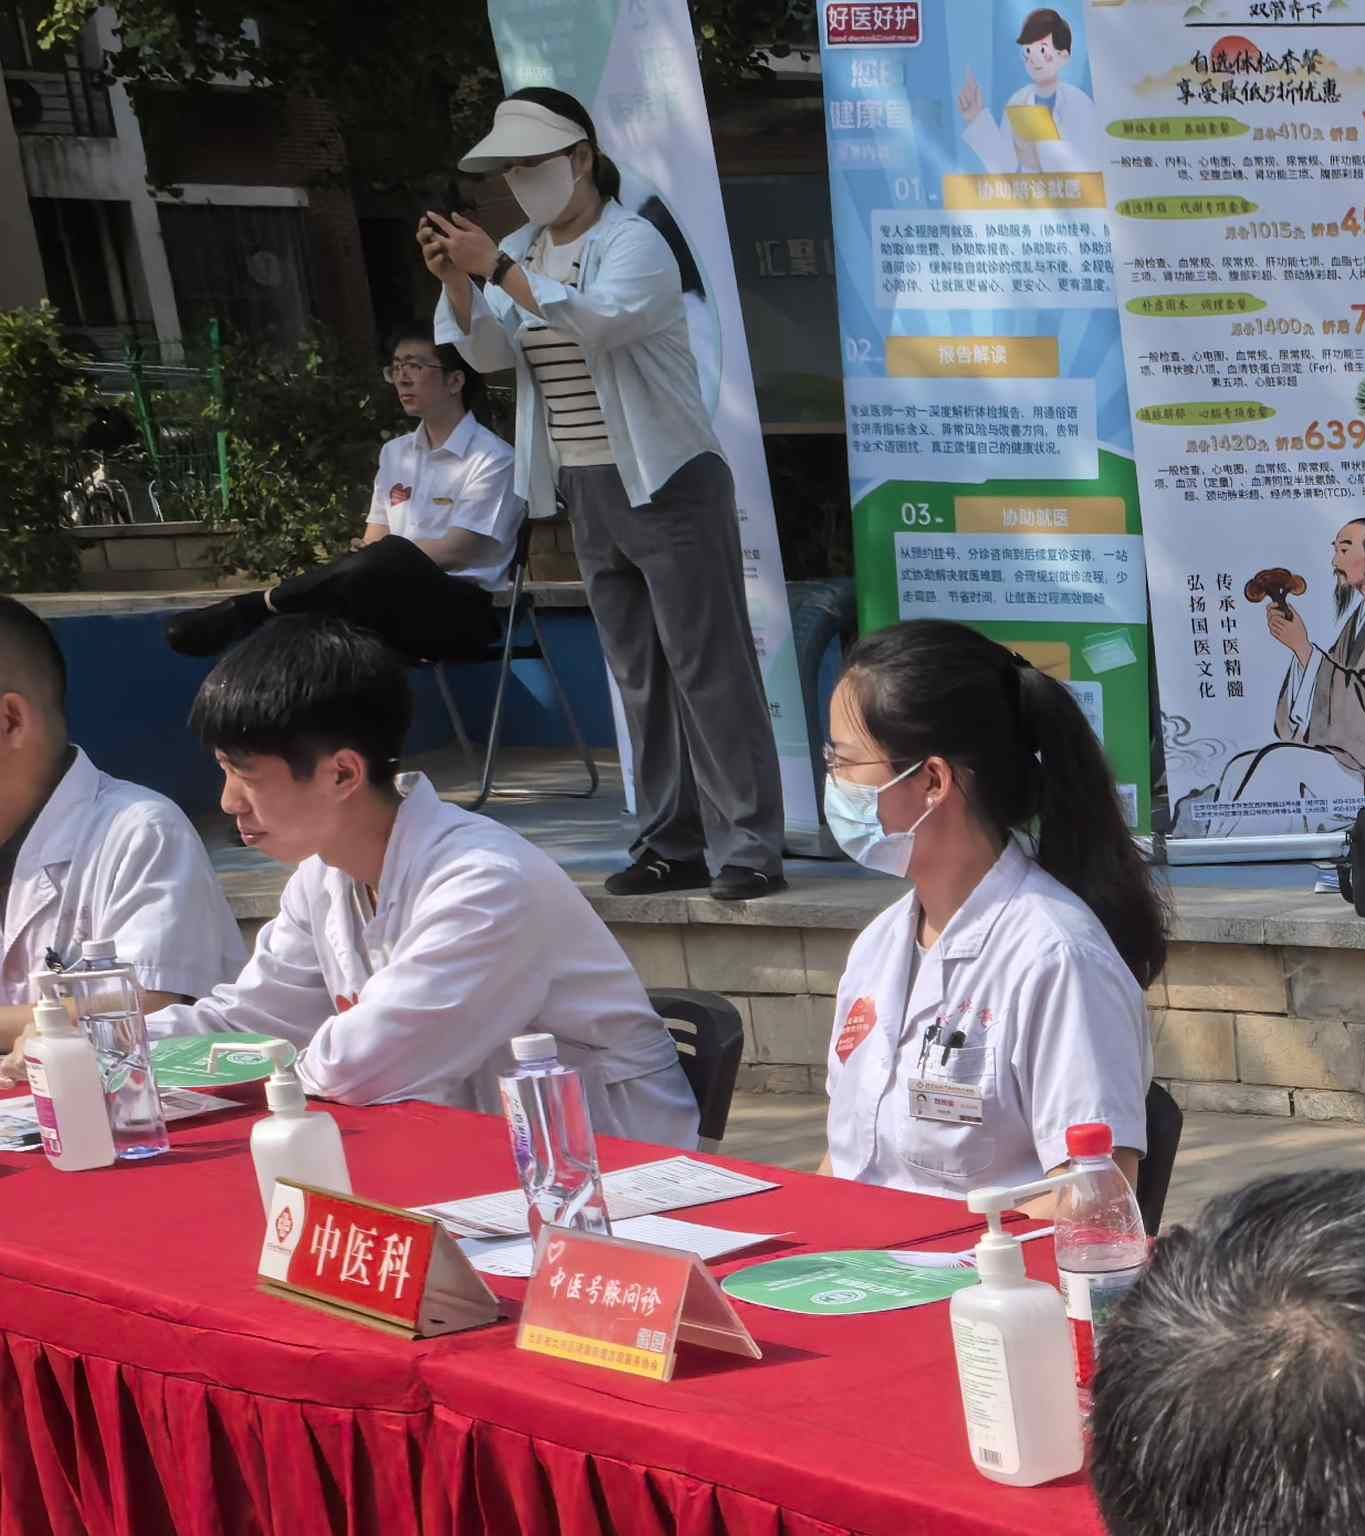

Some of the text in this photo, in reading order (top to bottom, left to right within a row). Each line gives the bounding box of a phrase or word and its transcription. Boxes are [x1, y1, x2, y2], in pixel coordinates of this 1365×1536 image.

[829, 6, 917, 31] 好医好护
[1190, 48, 1324, 75] 自选体检套餐
[1176, 79, 1342, 105] 享受最低5折优惠
[940, 345, 1008, 365] 报告解读
[1187, 574, 1216, 698] 弘扬国医文化
[1217, 573, 1244, 698] 传承中医精髓
[310, 1214, 413, 1299] 中医科
